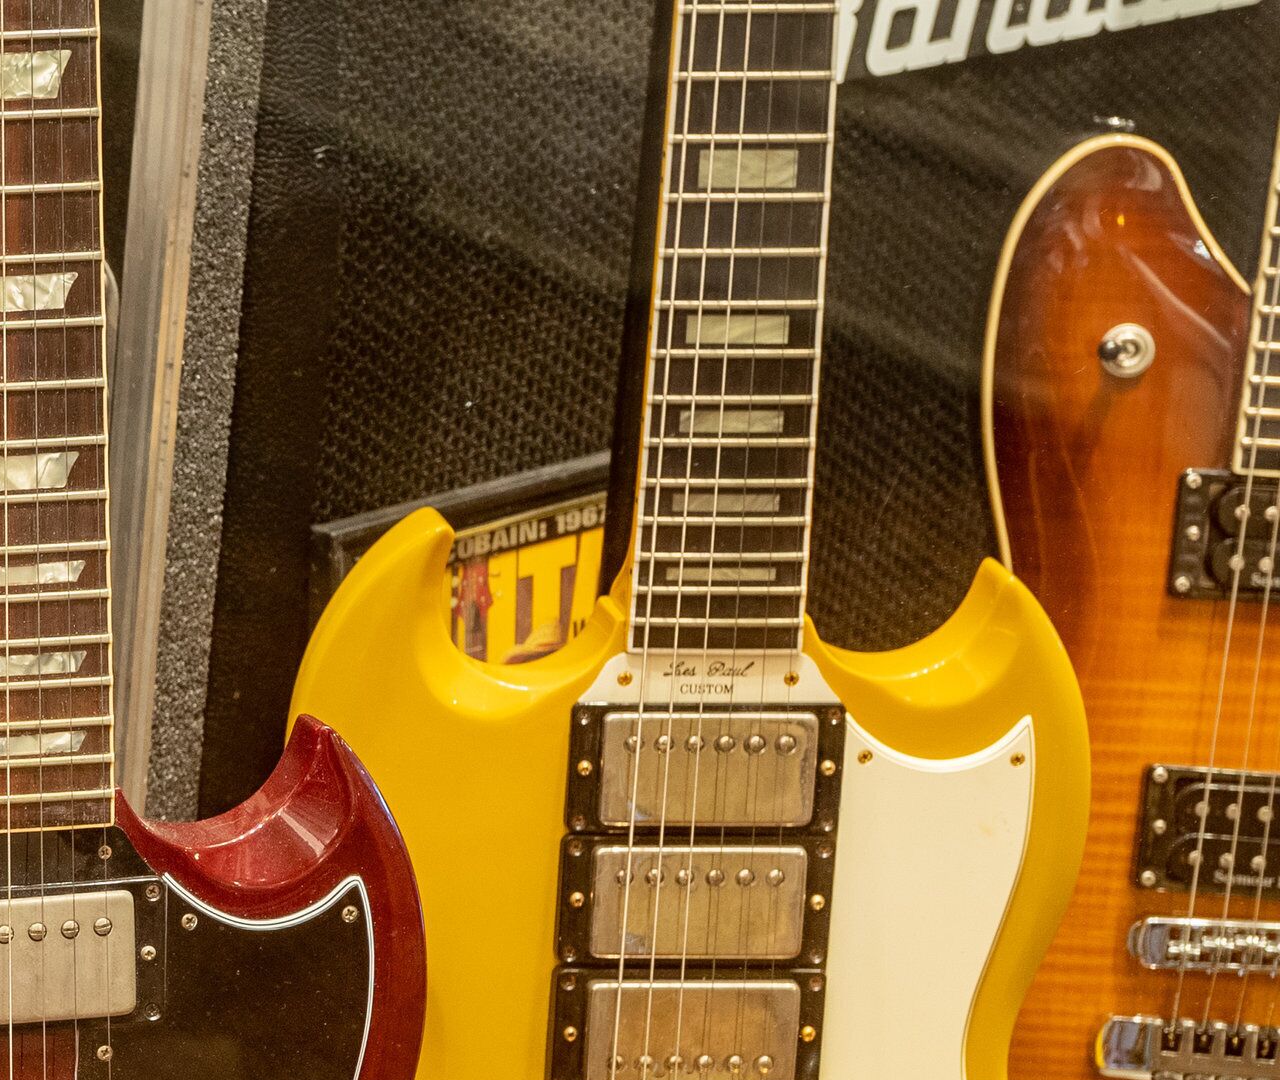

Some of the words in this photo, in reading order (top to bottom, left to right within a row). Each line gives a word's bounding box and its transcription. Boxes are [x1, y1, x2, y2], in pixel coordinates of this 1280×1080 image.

[662, 659, 697, 677] Les
[706, 660, 756, 678] Paul
[679, 683, 734, 696] CUSTOM
